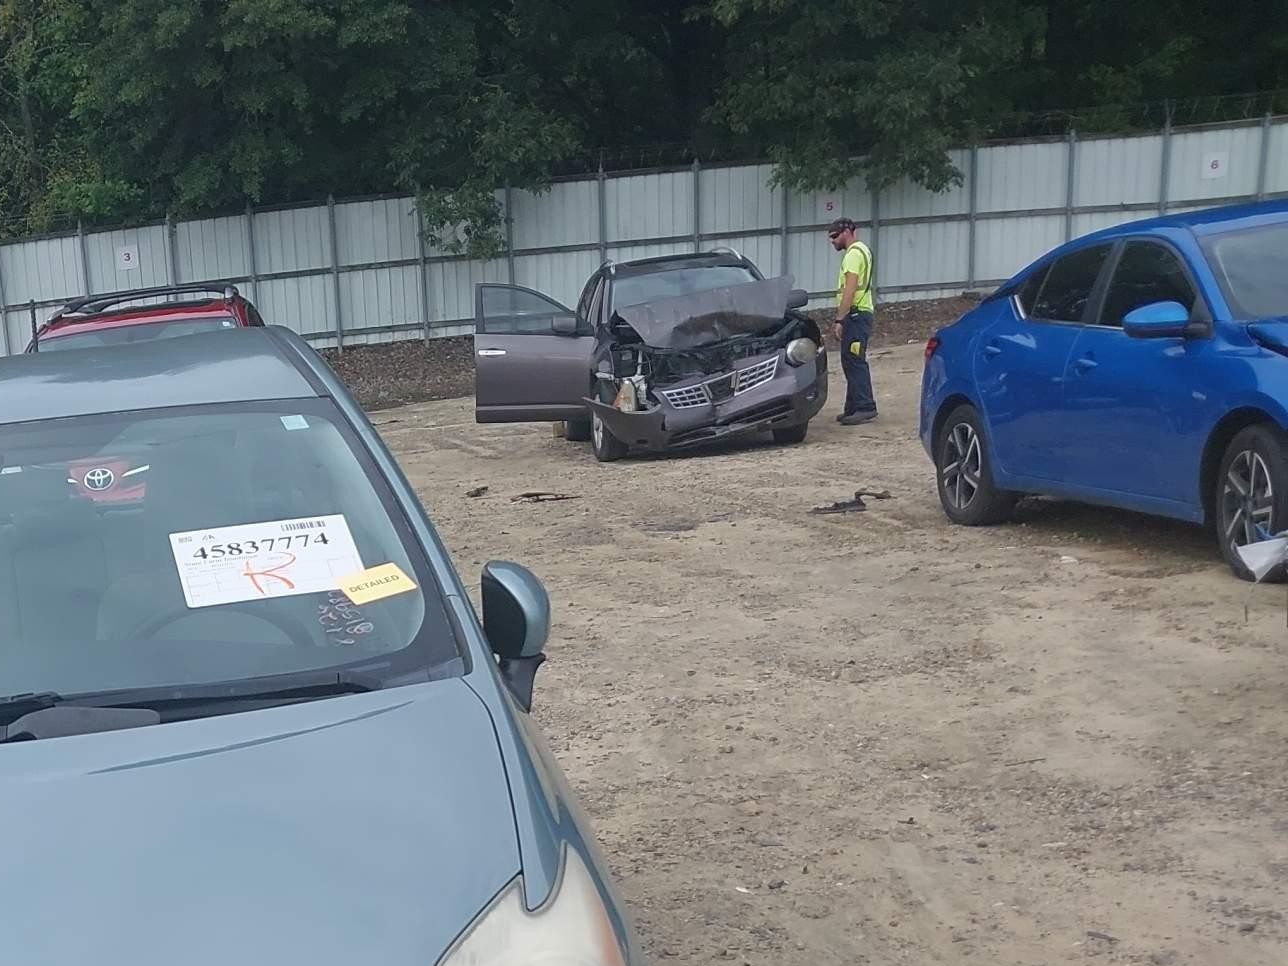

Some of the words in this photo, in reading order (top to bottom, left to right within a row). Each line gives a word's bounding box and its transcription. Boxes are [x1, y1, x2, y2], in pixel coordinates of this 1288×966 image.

[1210, 159, 1218, 170] 6
[826, 201, 834, 211] 5
[123, 252, 132, 262] 3
[192, 531, 331, 560] 45837774
[348, 574, 400, 593] DETAILED
